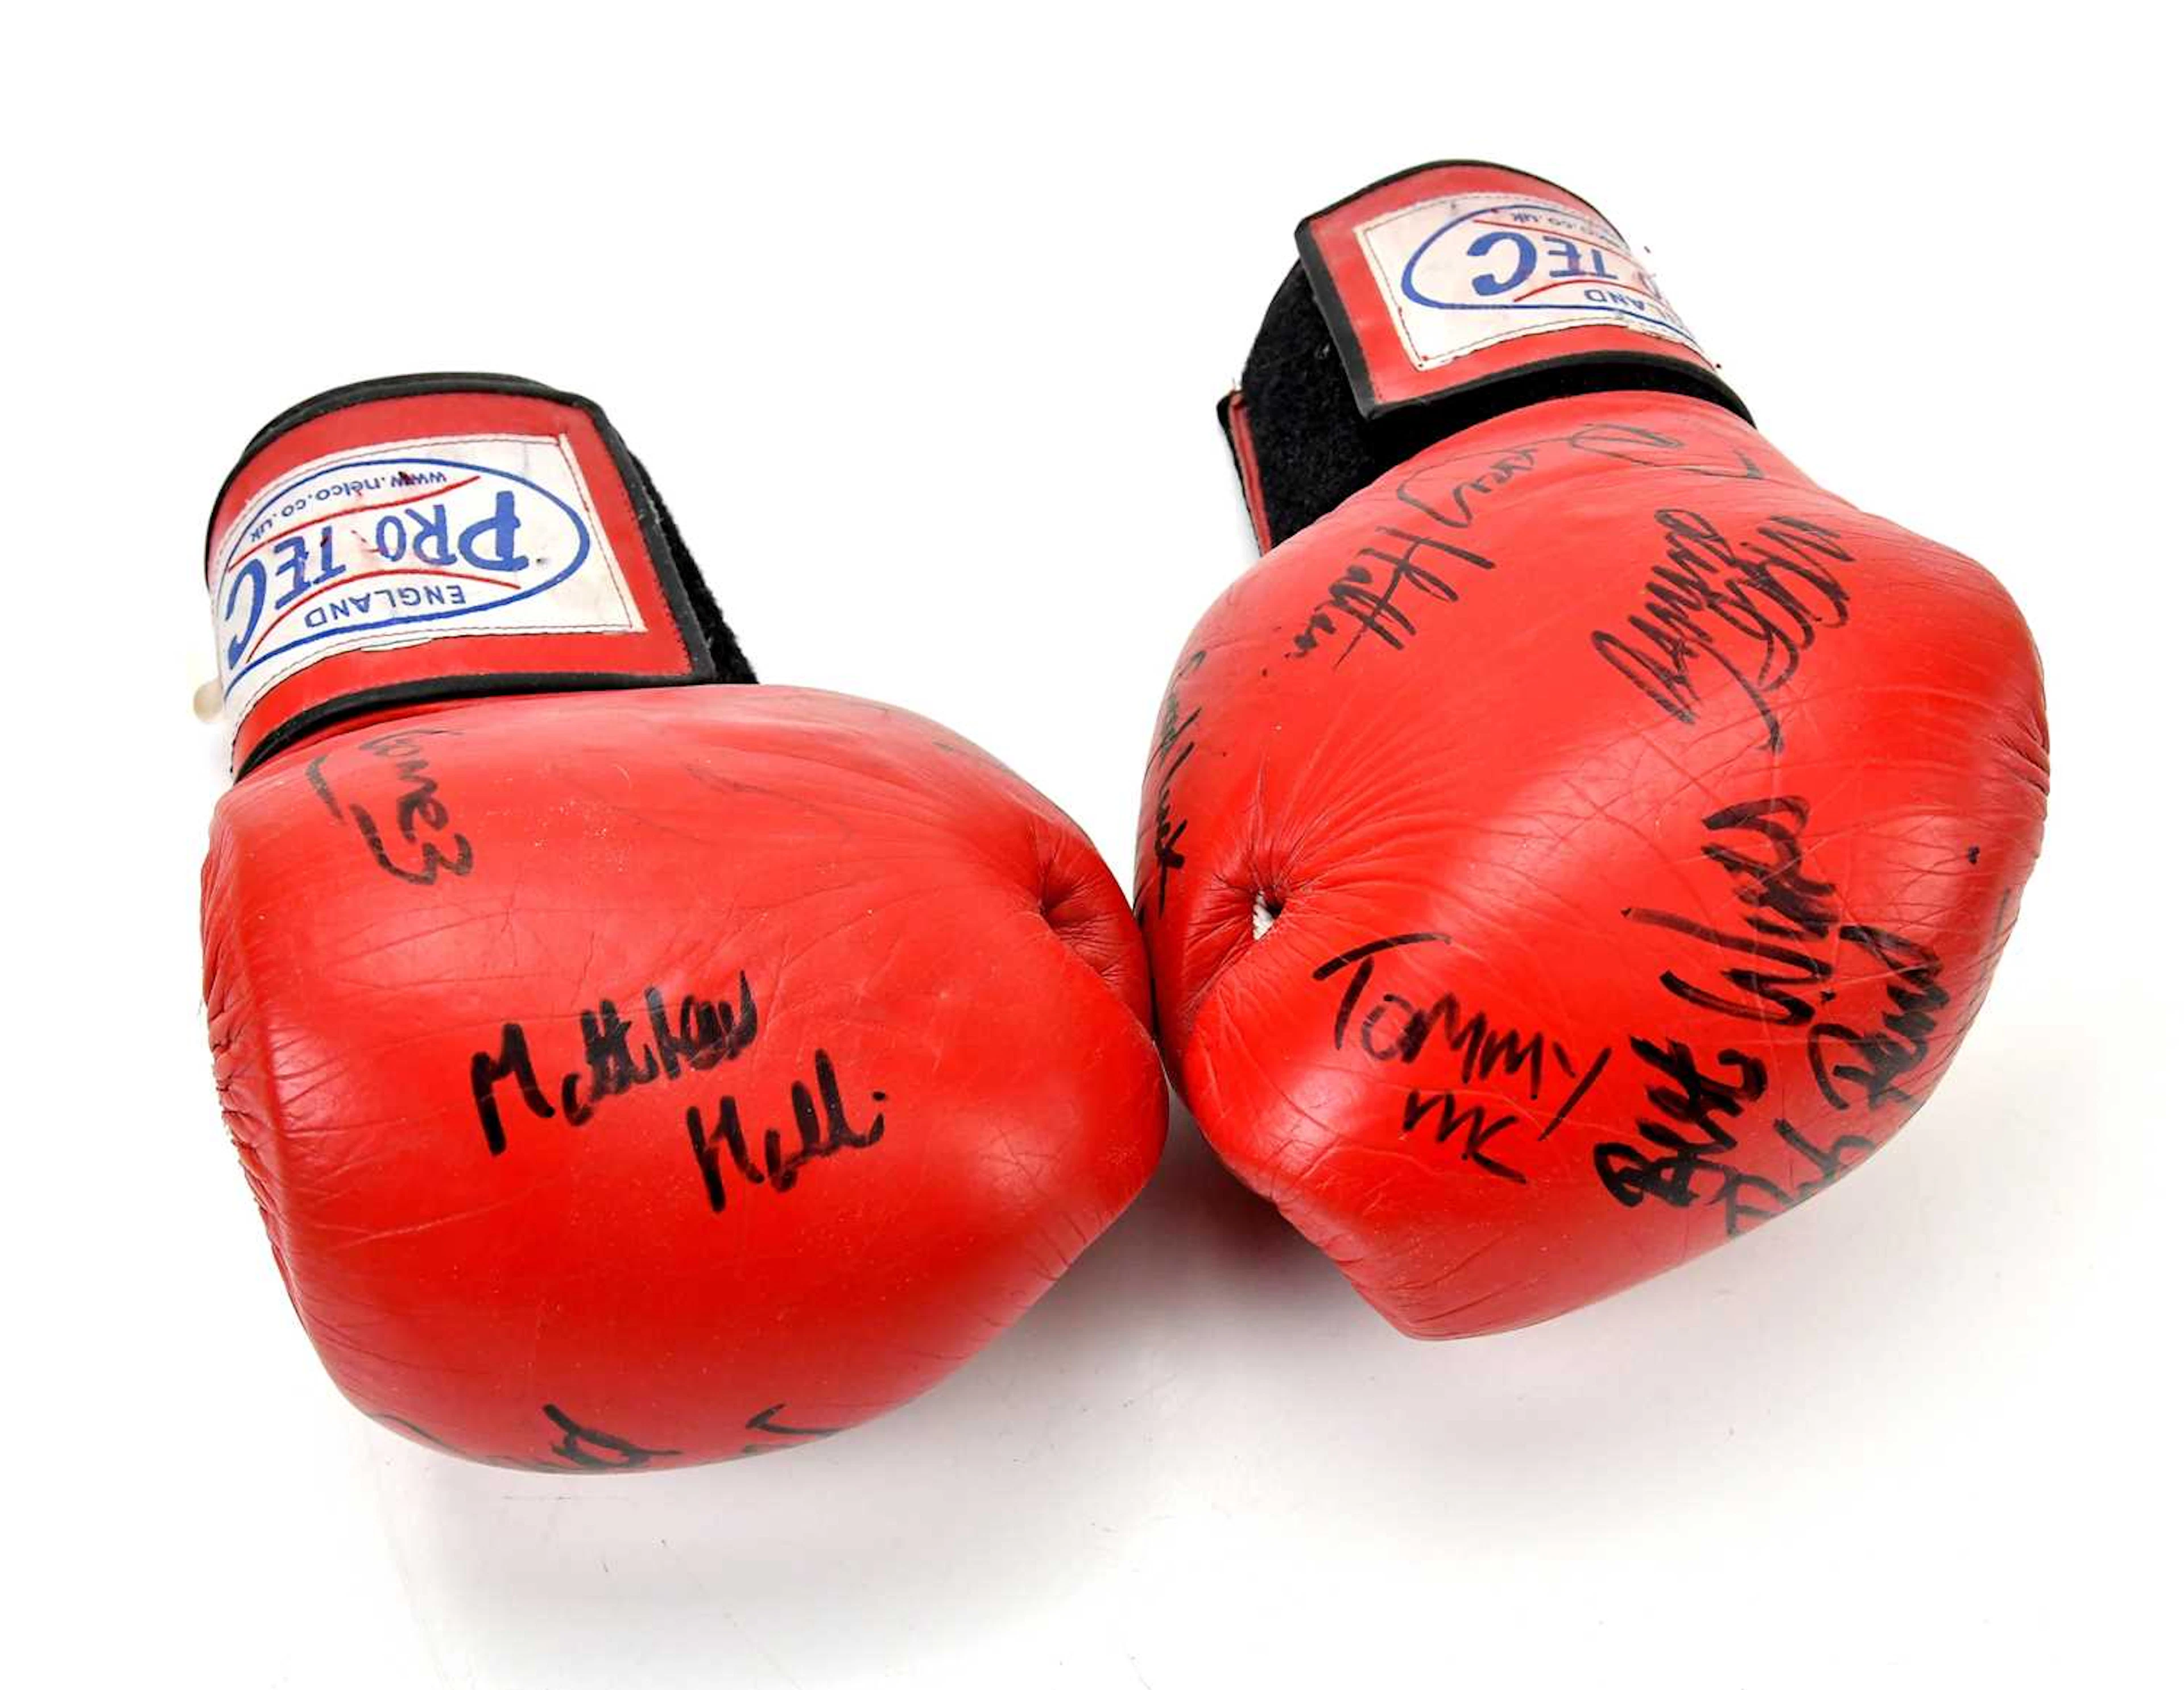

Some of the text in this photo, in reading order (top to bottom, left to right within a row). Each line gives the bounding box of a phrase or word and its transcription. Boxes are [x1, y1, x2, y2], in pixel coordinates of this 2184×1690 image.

[1466, 231, 1618, 296] TEC
[249, 469, 448, 543] www.nelco.co.uk
[225, 490, 529, 669] PRO TEC
[304, 584, 466, 629] ENGLAND
